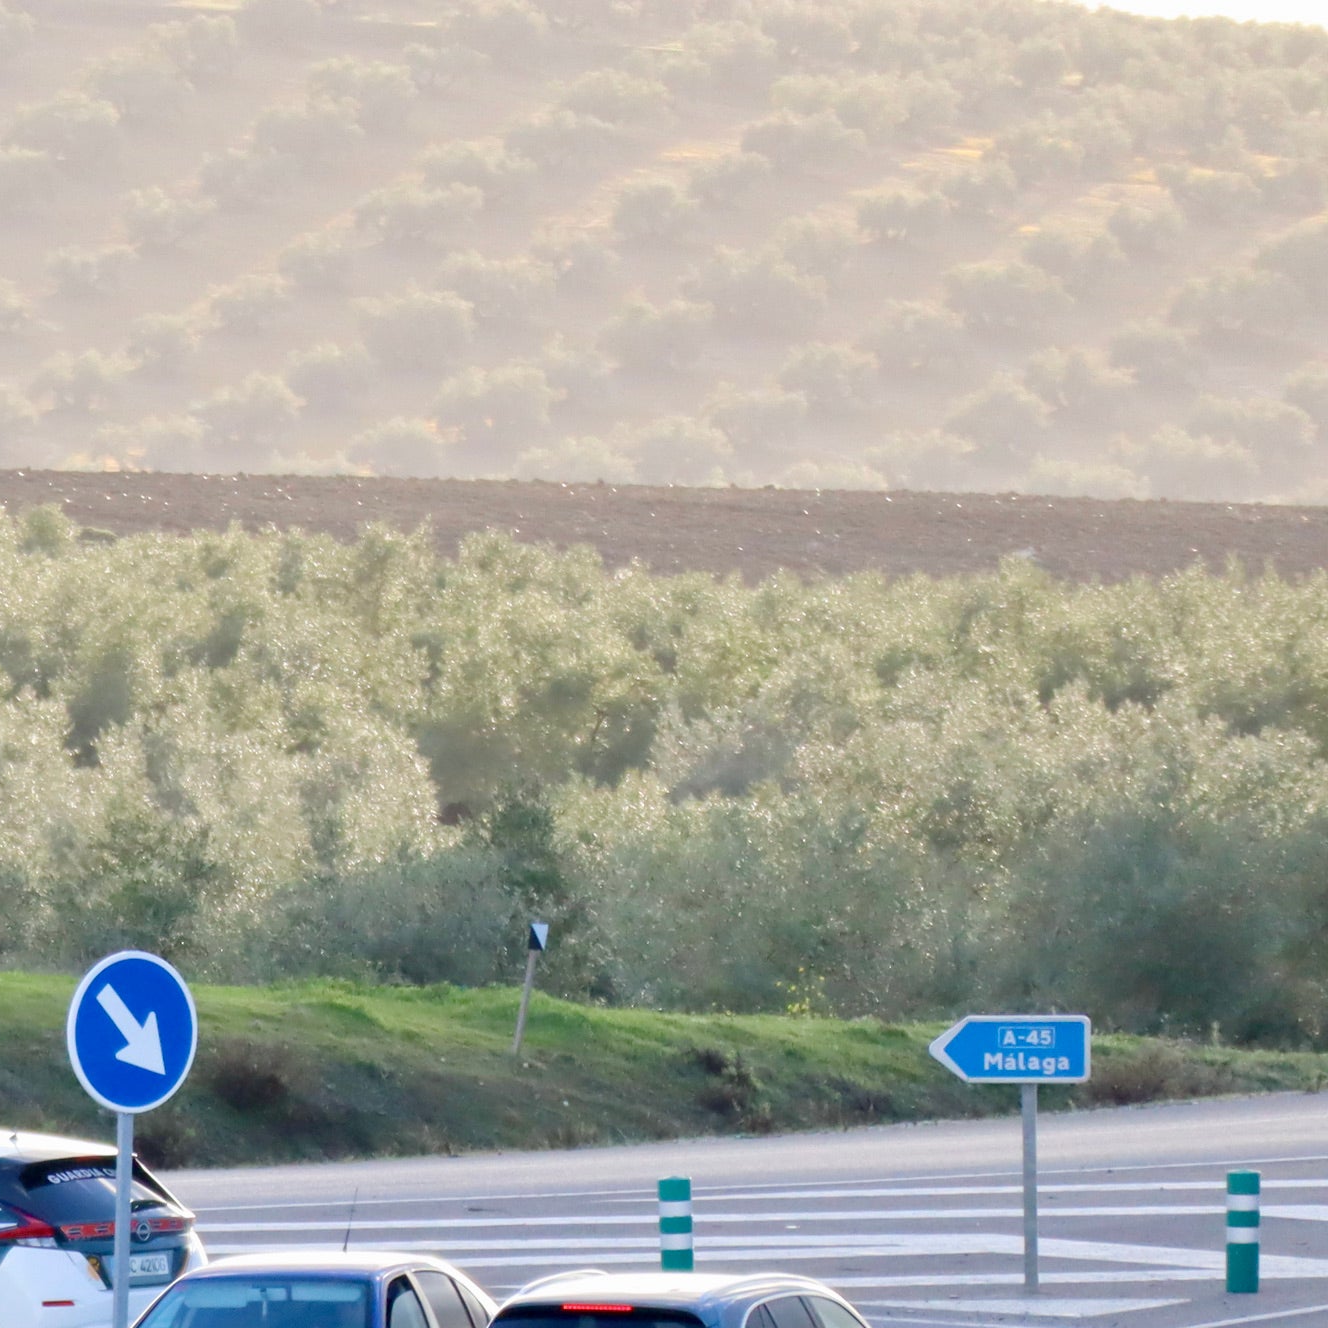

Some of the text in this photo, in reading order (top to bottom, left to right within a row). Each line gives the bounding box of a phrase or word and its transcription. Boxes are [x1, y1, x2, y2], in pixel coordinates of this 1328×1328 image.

[1003, 1029, 1052, 1046] A-45
[984, 1052, 1070, 1075] Málaga
[47, 1167, 106, 1184] GUARDIA
